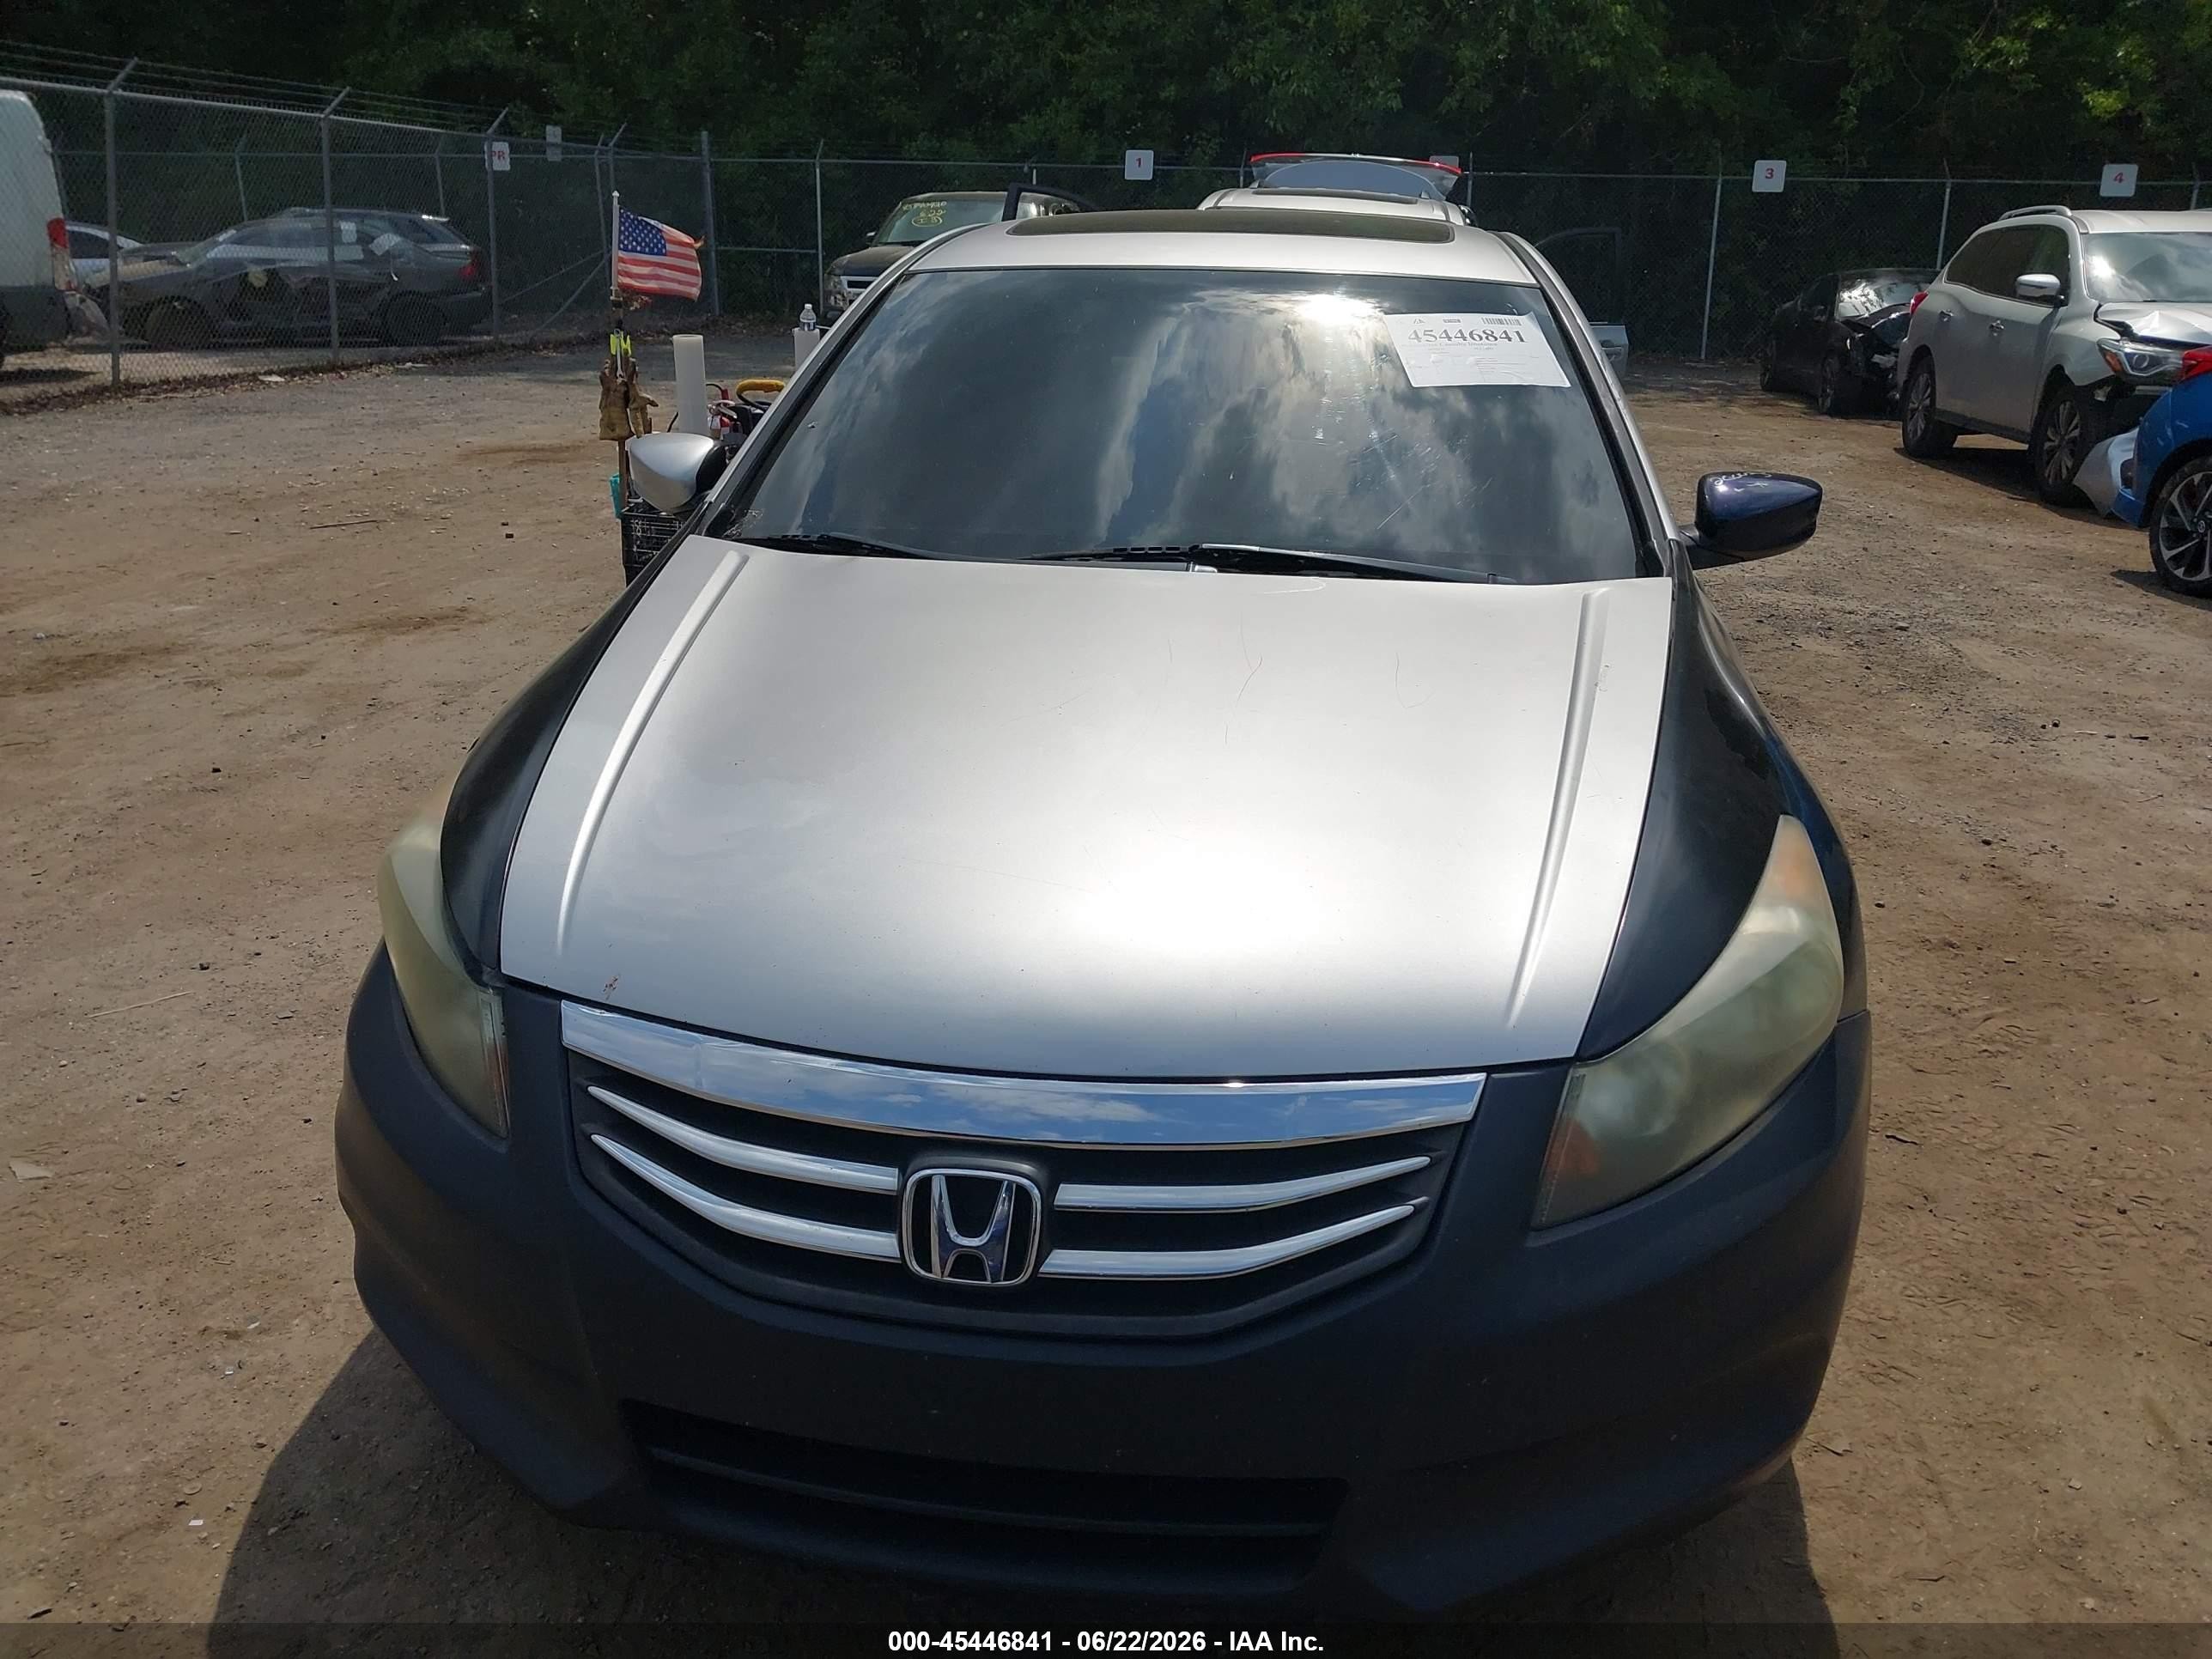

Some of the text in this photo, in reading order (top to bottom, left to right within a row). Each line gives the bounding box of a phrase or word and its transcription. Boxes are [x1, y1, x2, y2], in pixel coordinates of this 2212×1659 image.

[1135, 157, 1142, 168] 1
[1765, 167, 1774, 179] 3
[2113, 172, 2124, 184] 4
[1408, 329, 1529, 343] 45446841
